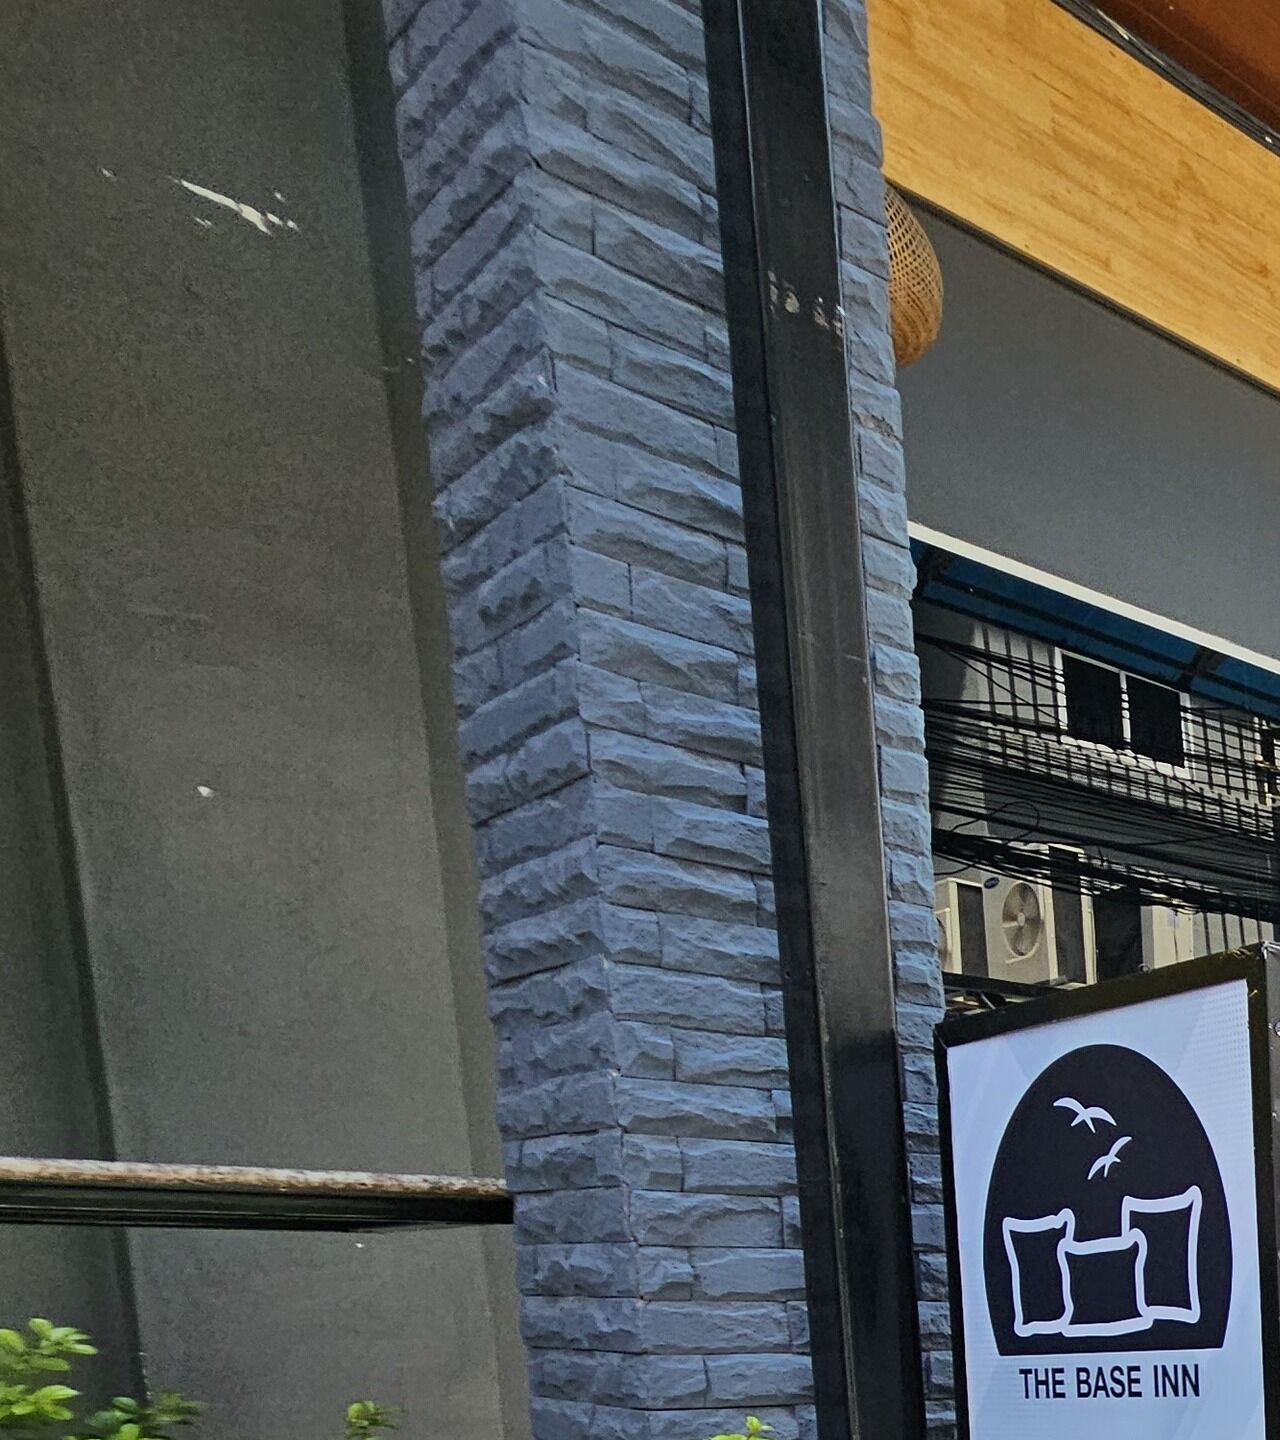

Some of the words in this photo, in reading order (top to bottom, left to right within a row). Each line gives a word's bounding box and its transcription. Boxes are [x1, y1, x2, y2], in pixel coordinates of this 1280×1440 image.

[1018, 1366, 1066, 1399] THE
[1077, 1364, 1143, 1398] BASE
[1153, 1363, 1200, 1398] INN
